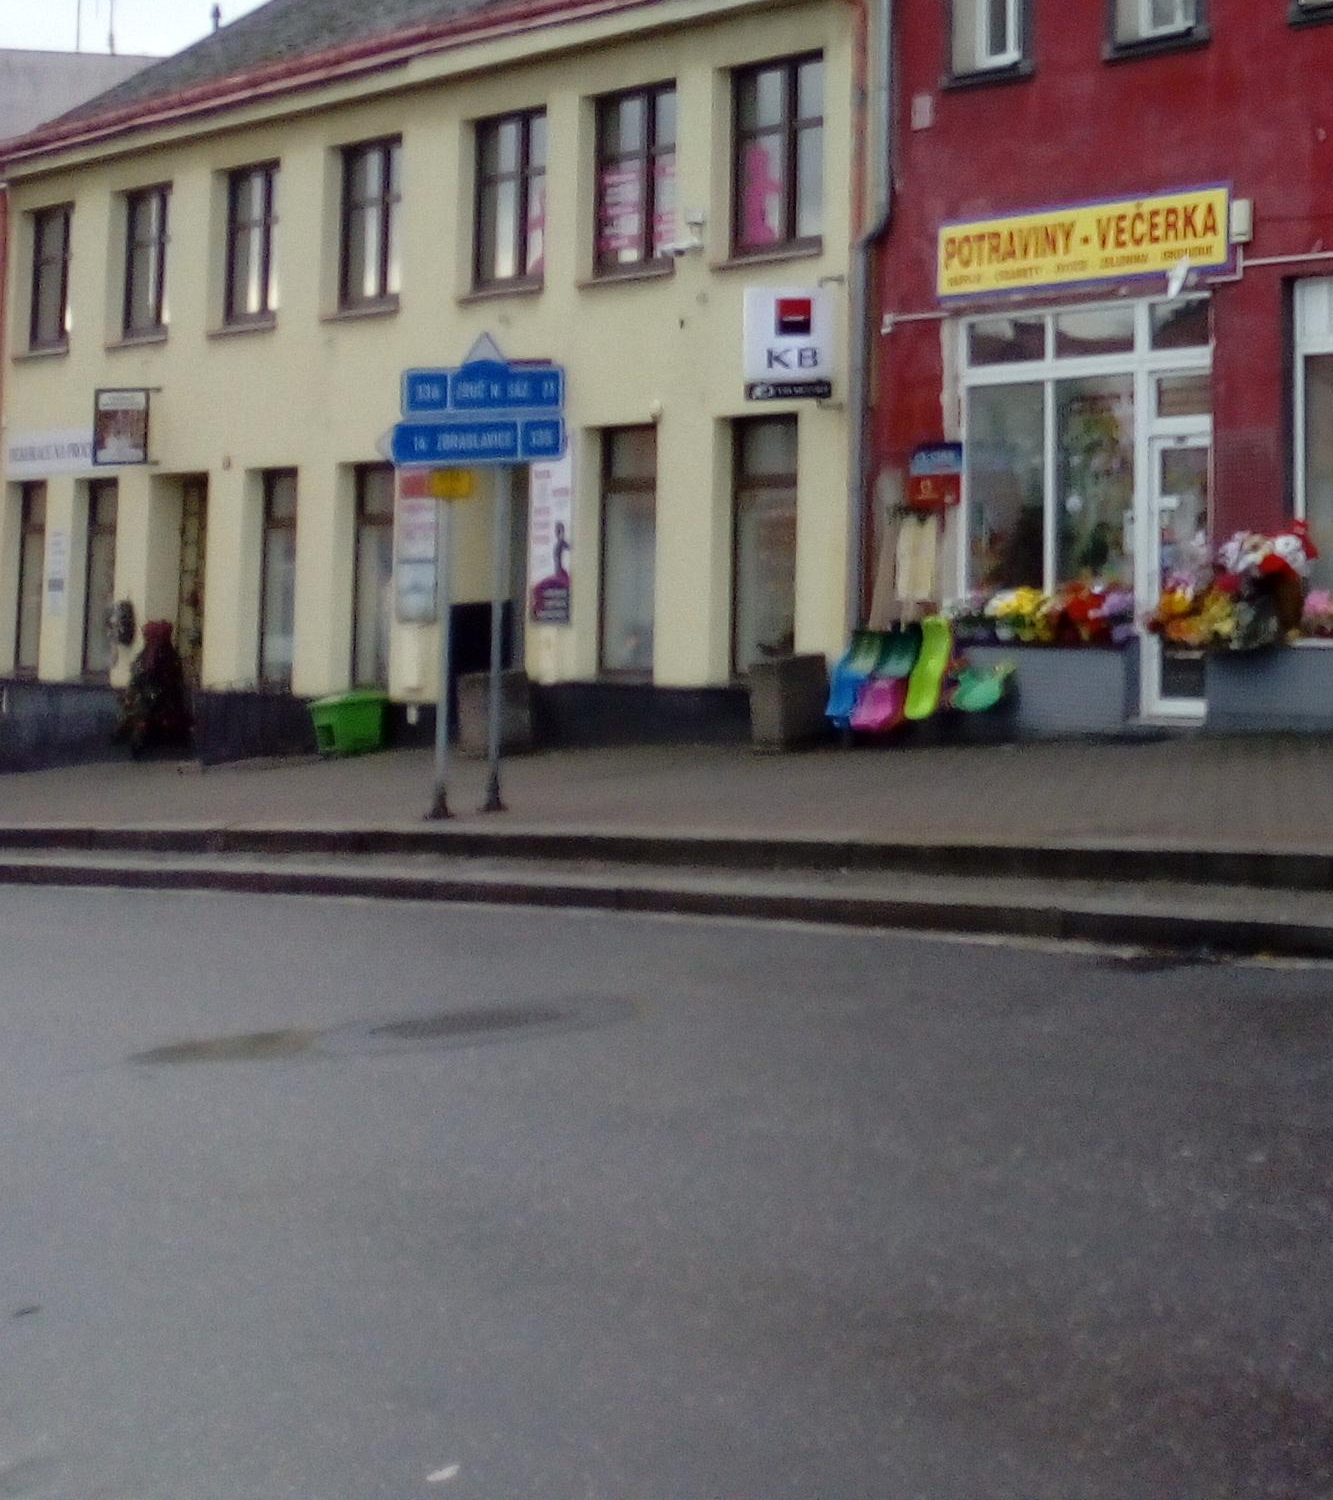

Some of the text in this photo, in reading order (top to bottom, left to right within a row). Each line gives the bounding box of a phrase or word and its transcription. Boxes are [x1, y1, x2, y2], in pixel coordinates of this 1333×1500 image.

[944, 219, 1076, 270] POTRAVINY
[1096, 202, 1218, 251] VEČERKA
[766, 347, 819, 370] KB
